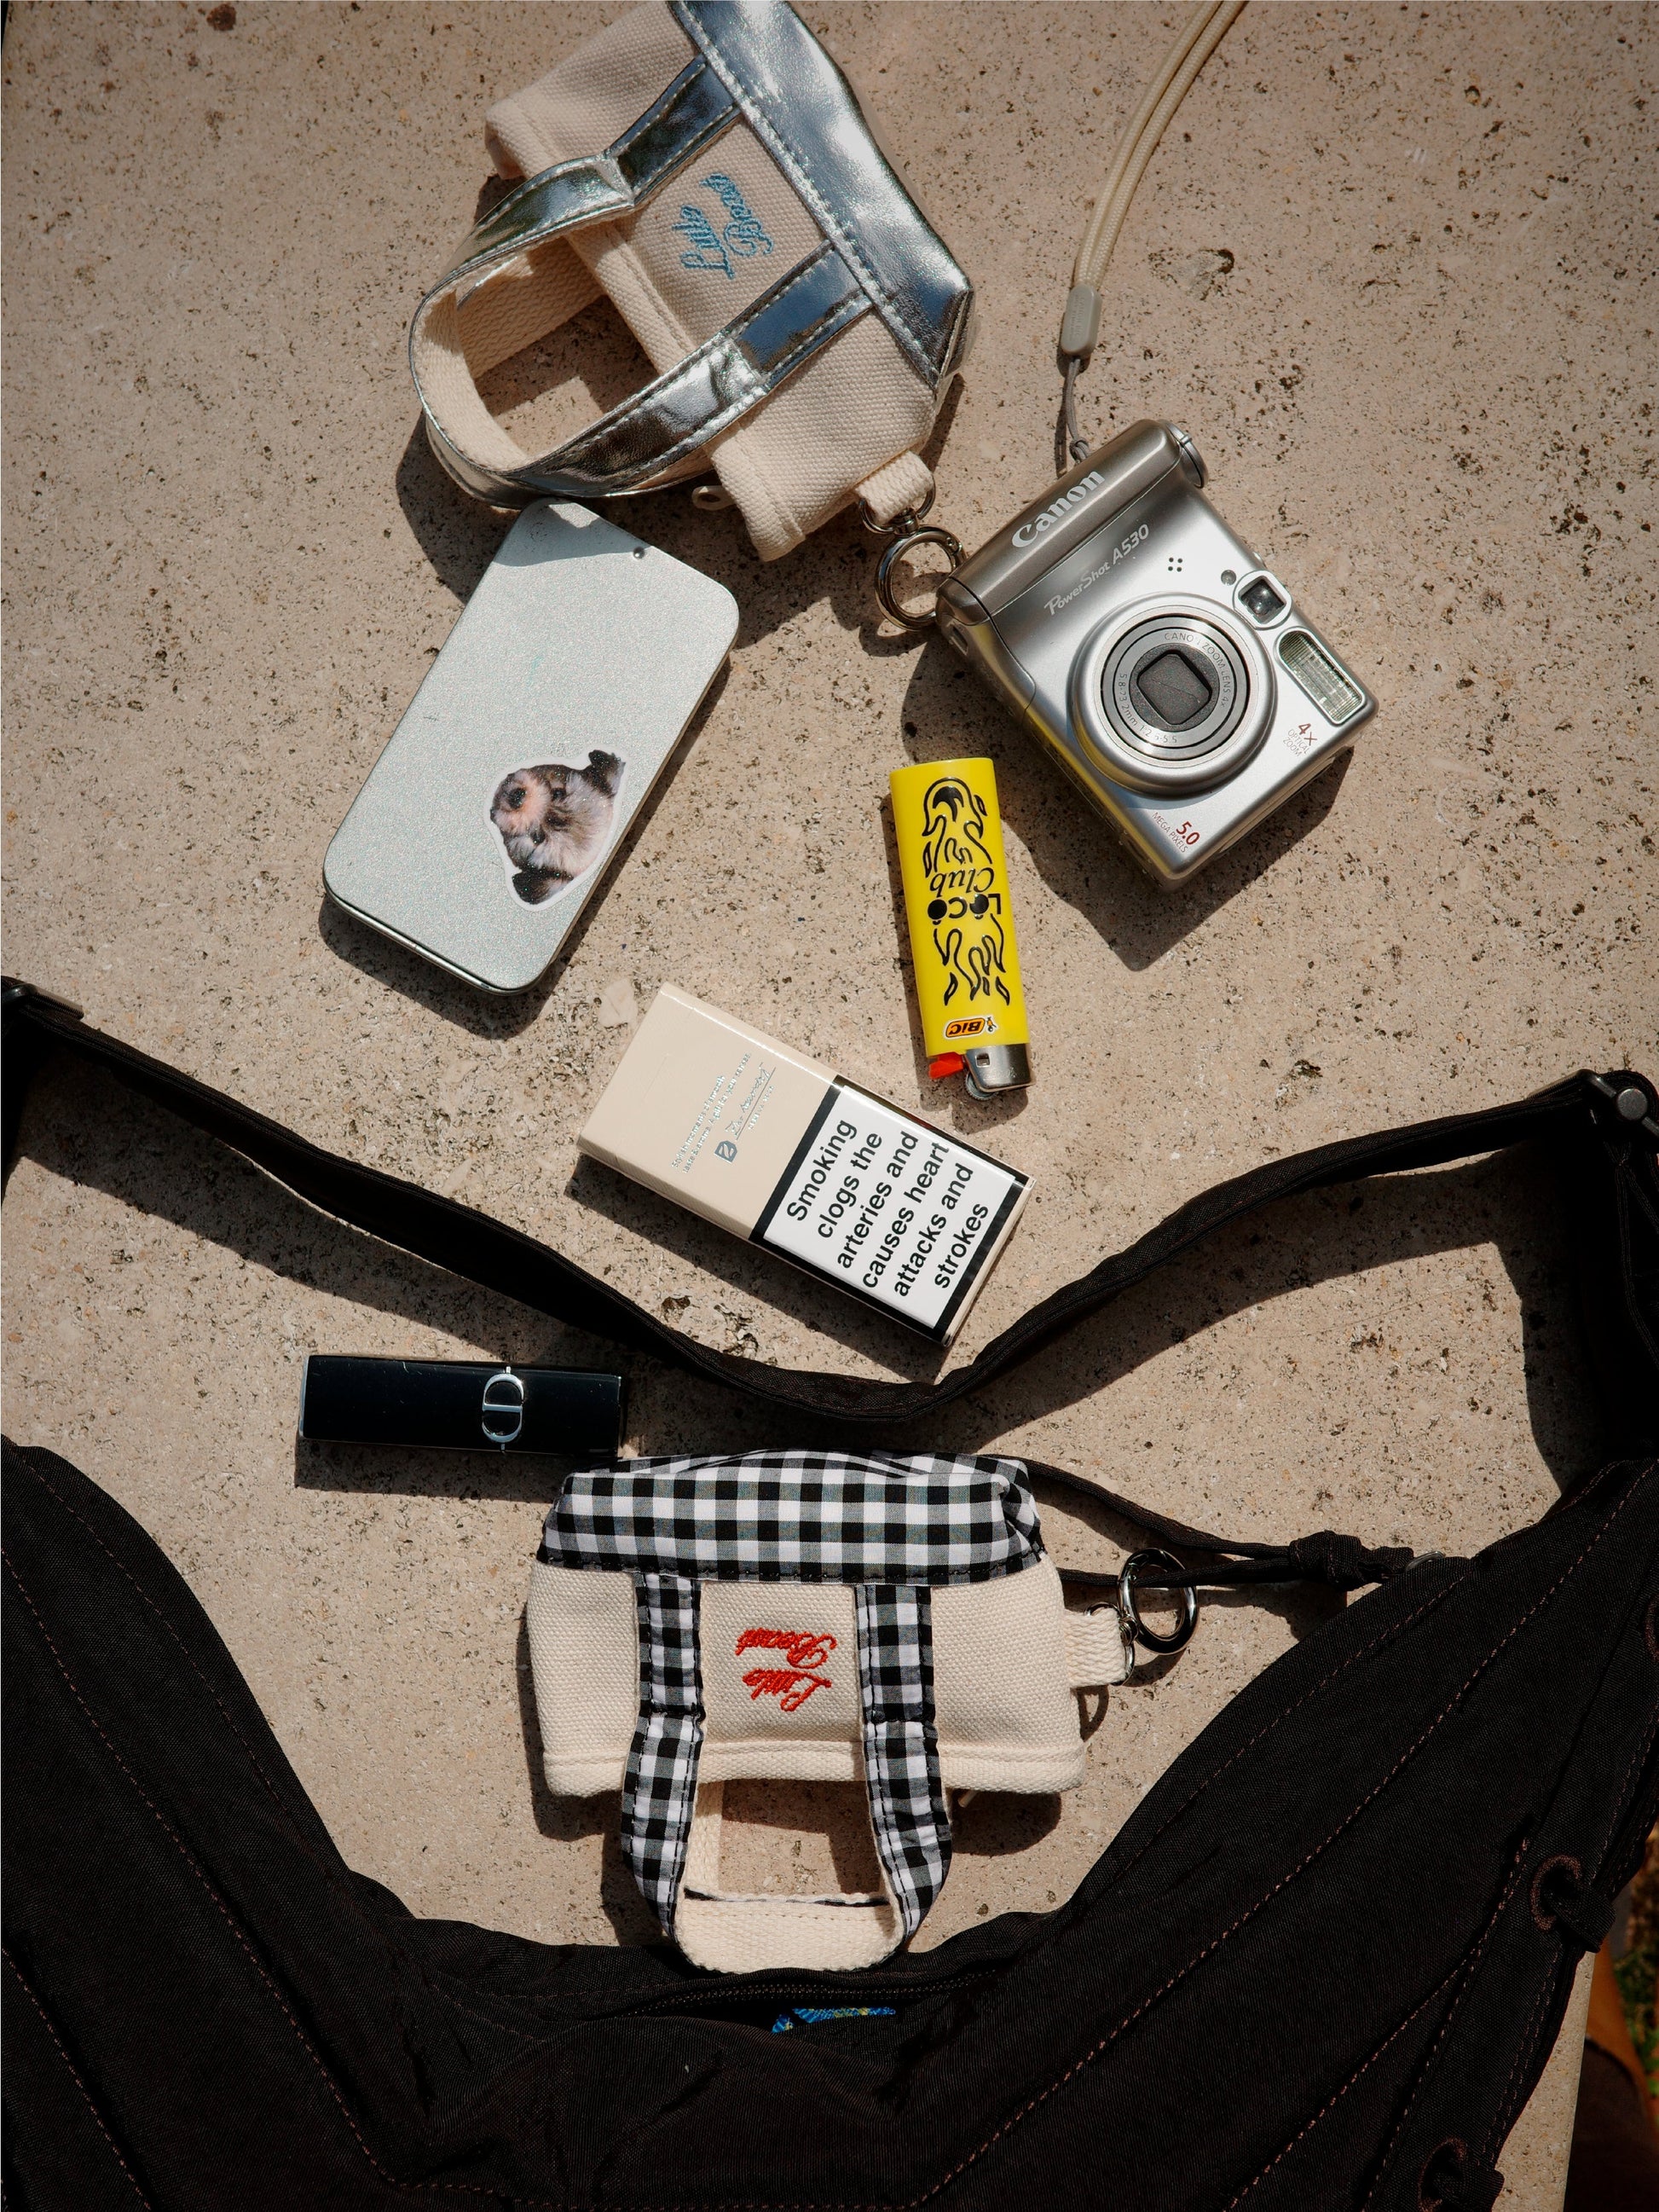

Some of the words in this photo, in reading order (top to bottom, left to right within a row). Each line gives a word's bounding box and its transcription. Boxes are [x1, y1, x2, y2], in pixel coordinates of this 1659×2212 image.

[1012, 471, 1106, 547] Canon
[1043, 561, 1111, 616] PowerShot
[1113, 524, 1149, 565] A530
[1202, 641, 1226, 669] ZOOM
[1221, 670, 1231, 693] LENS
[1283, 737, 1302, 756] ZOOM
[1288, 729, 1309, 754] OPTICAL
[1152, 812, 1171, 833] MEGA
[1169, 831, 1188, 853] PIXELS
[1176, 820, 1200, 845] 5.0
[929, 867, 995, 898] Club
[786, 1120, 858, 1221] Smoking
[818, 1175, 860, 1238] clogs
[851, 1132, 882, 1171] the
[837, 1182, 893, 1268] arteries
[887, 1131, 919, 1178] and
[863, 1207, 915, 1288] causes
[904, 1142, 950, 1203] heart
[894, 1213, 947, 1296] attacks
[941, 1162, 974, 1210] and
[934, 1203, 989, 1288] strokes
